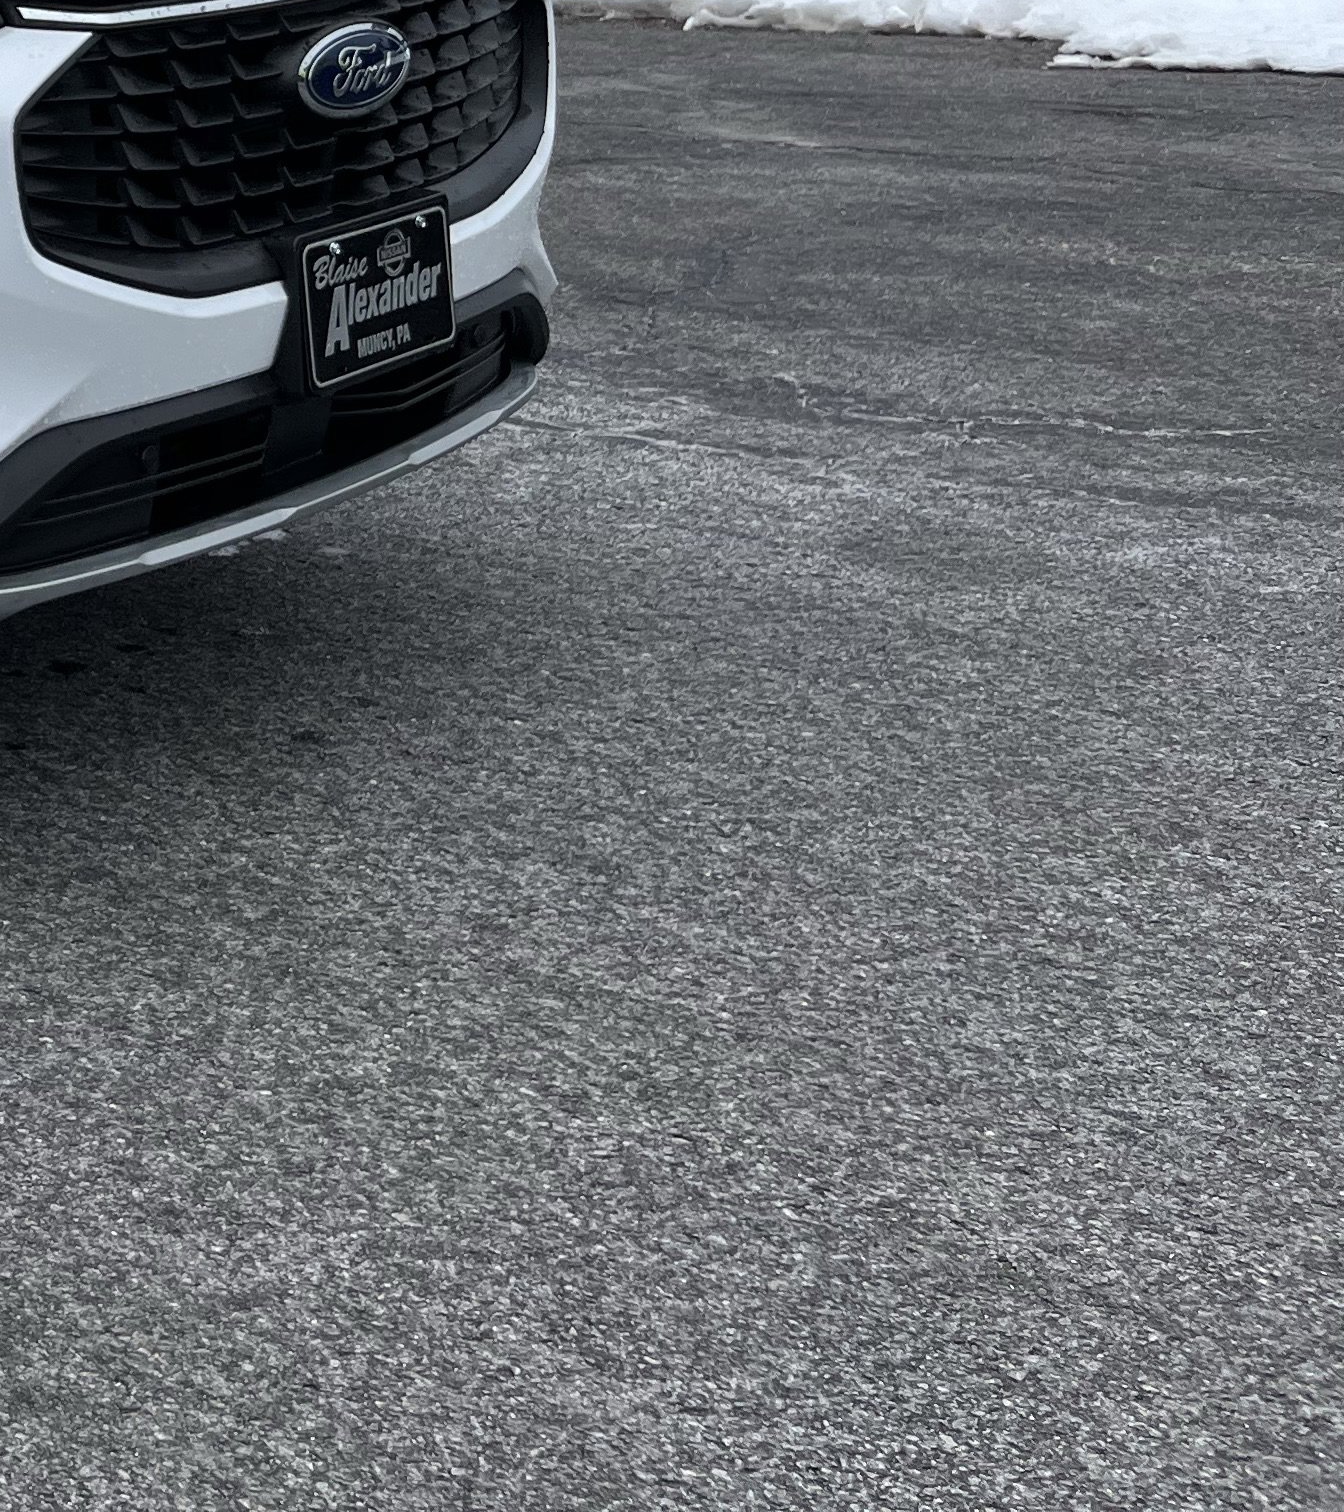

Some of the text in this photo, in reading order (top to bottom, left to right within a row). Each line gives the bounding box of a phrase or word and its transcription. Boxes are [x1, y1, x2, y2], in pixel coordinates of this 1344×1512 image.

[332, 43, 392, 98] Ford
[380, 243, 407, 260] NISSAN
[313, 254, 369, 290] Blaise
[325, 260, 442, 357] Alexander
[357, 322, 411, 359] MUNCY, PA
